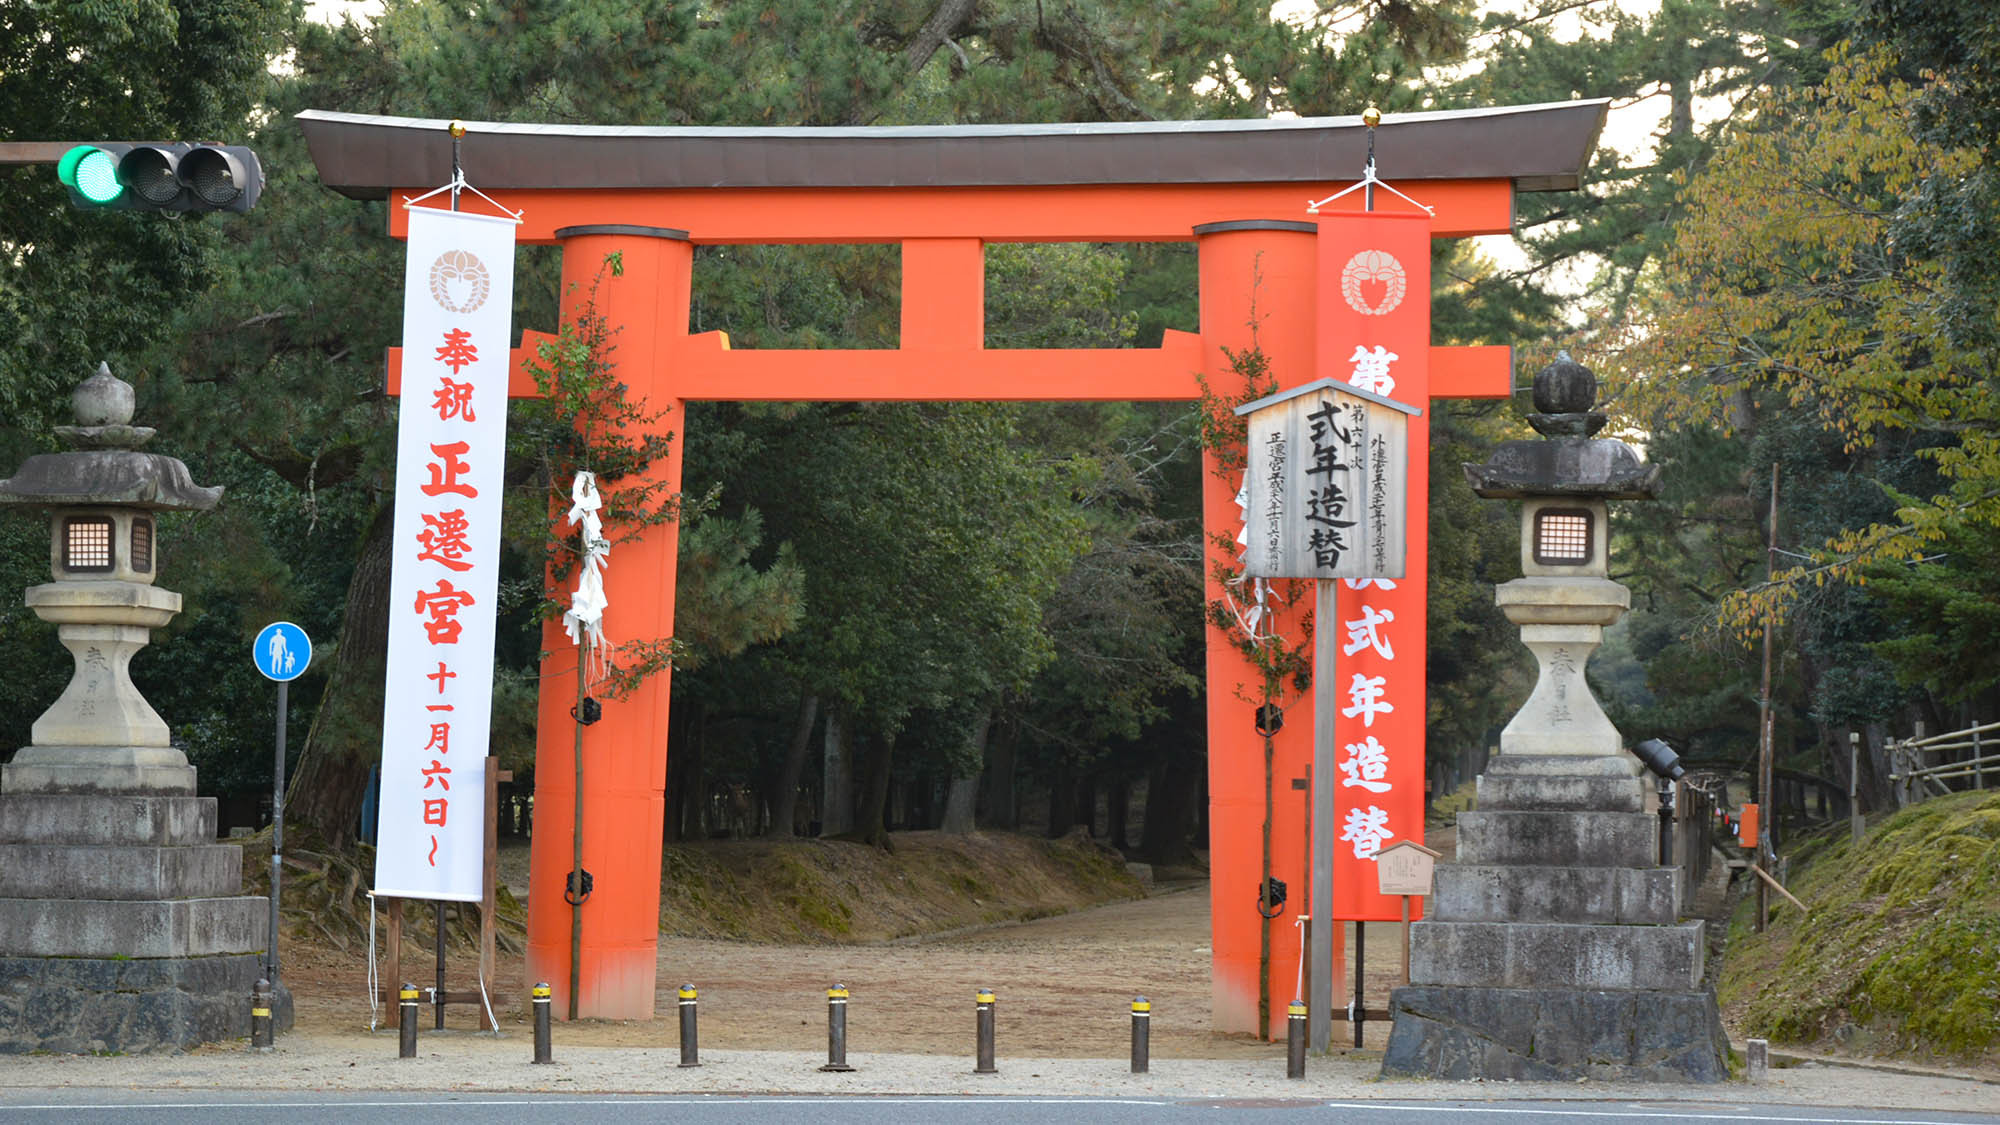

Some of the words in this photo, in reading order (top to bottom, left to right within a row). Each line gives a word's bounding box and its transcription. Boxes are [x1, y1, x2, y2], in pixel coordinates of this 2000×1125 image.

[432, 327, 480, 423] 奉祝
[1349, 404, 1365, 471] 第六十次
[414, 440, 479, 646] 正遷宮
[1305, 400, 1358, 570] 式年造替
